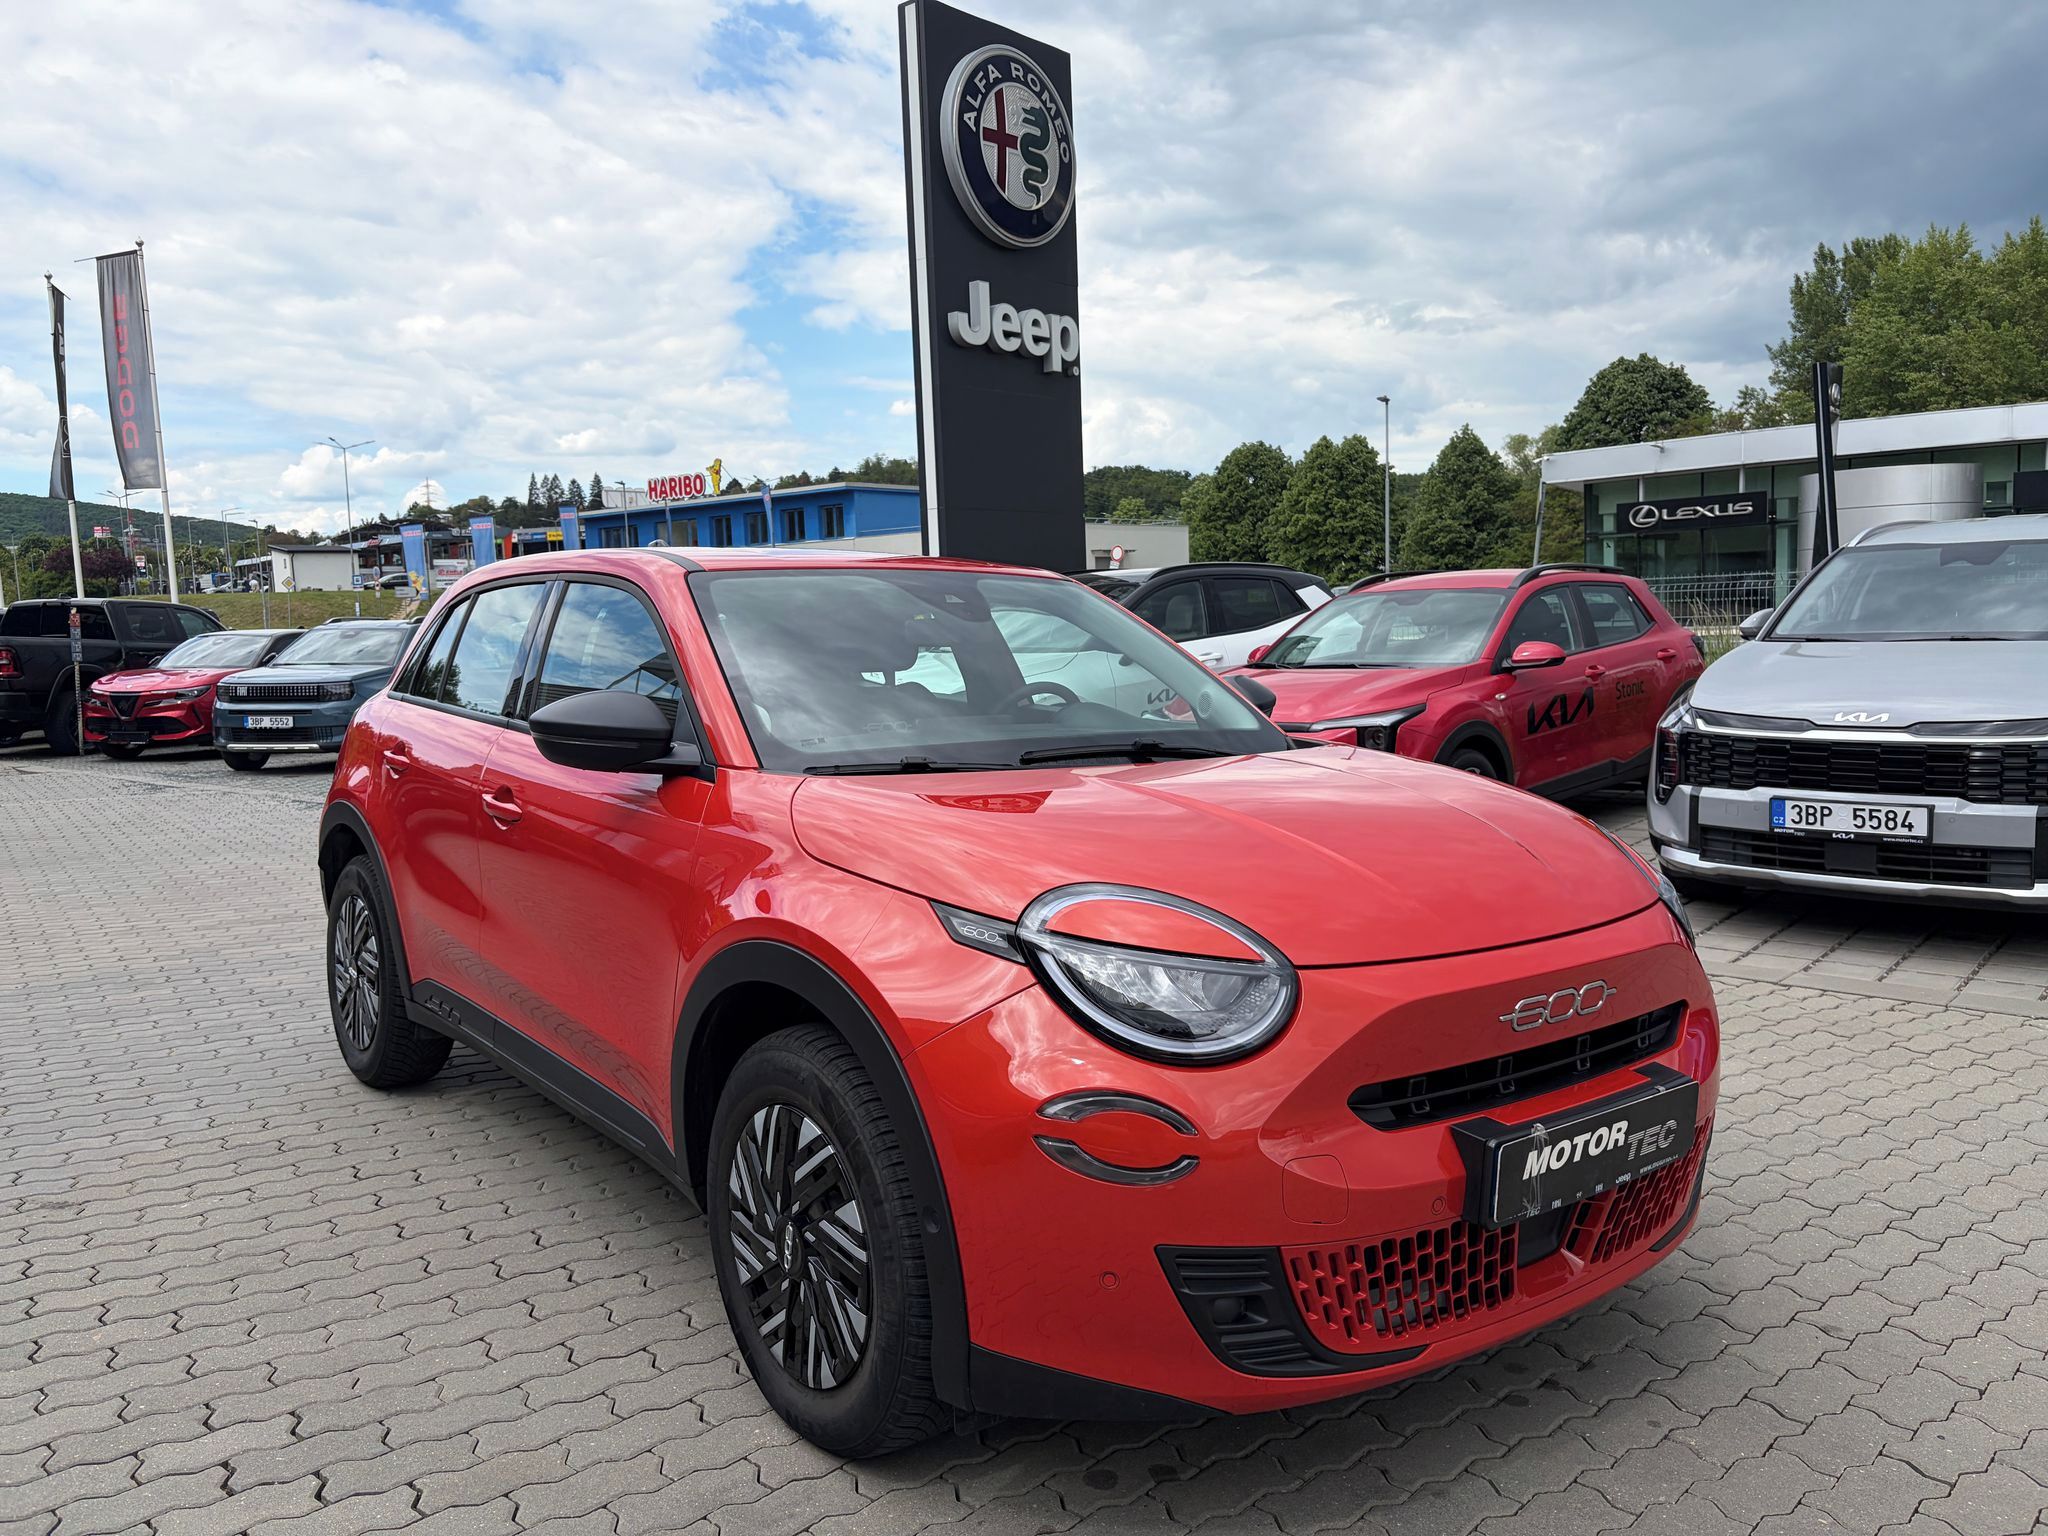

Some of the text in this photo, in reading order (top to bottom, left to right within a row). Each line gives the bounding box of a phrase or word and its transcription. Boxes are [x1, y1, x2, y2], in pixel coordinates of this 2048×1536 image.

[963, 61, 1069, 163] ALFA ROMEO
[948, 280, 1079, 373] Jeep
[648, 473, 706, 502] HARIBO
[1662, 501, 1754, 520] LEXUS
[1615, 681, 1644, 700] Stonic
[250, 717, 290, 726] 3BP 5552
[1527, 687, 1595, 735] KIA
[1834, 712, 1889, 723] KIA
[1790, 804, 1833, 826] 3BP
[1852, 807, 1914, 832] 5584
[962, 924, 1001, 943] 600
[1504, 980, 1612, 1032] 600
